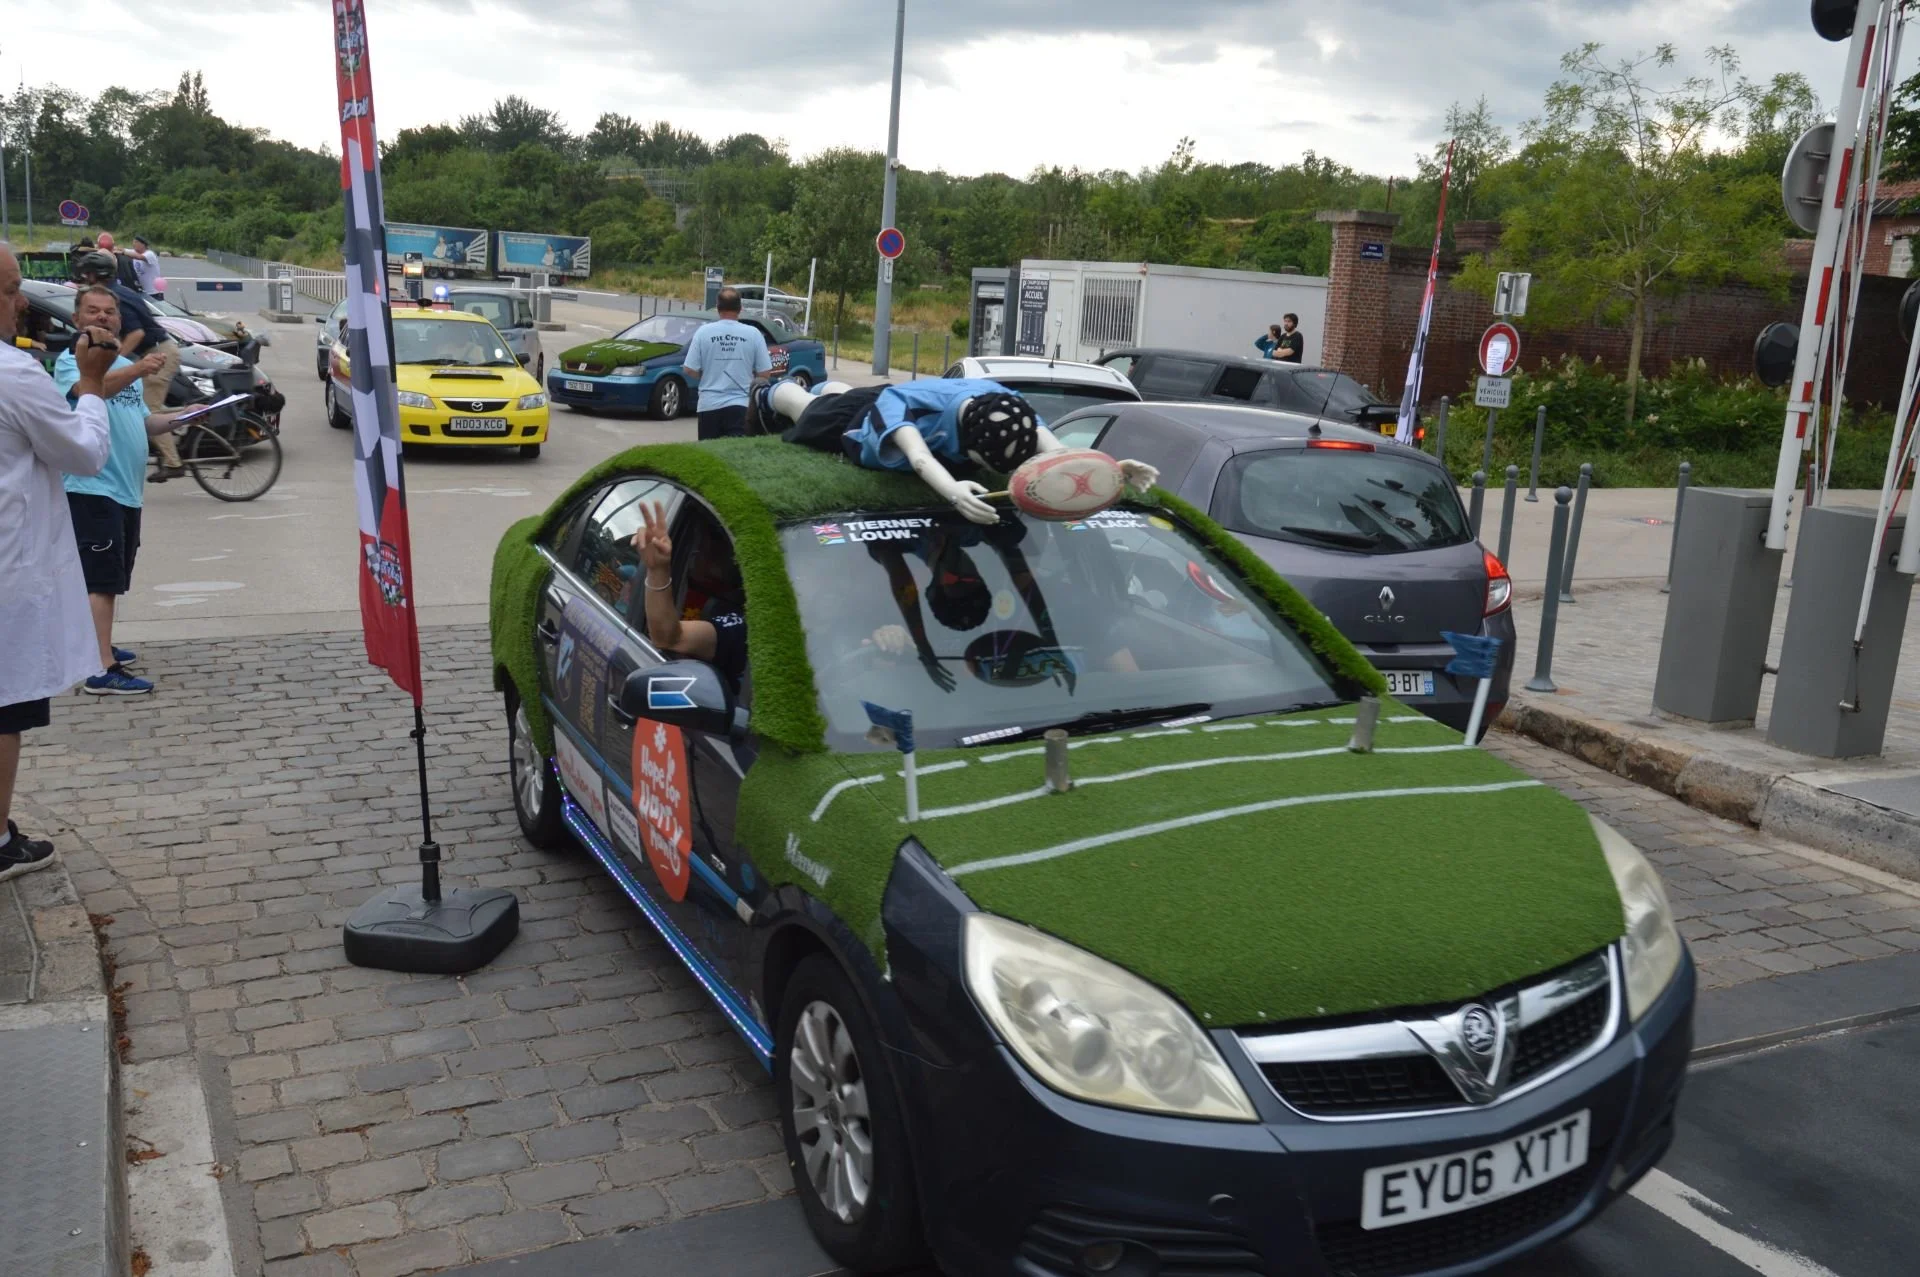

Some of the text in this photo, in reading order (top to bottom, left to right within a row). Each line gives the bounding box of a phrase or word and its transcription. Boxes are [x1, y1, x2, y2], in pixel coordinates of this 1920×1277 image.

[1025, 291, 1043, 300] ACCUEIL
[710, 334, 747, 343] Pit Crew
[455, 420, 503, 429] HD03 KCG
[842, 518, 933, 531] TIERNEY
[1085, 519, 1142, 529] FLACK
[848, 529, 913, 542] LOUW
[1363, 615, 1405, 623] CLIO
[1381, 673, 1420, 693] 3-BT
[640, 744, 665, 790] Hope
[1380, 1118, 1580, 1218] EY06 XTT
